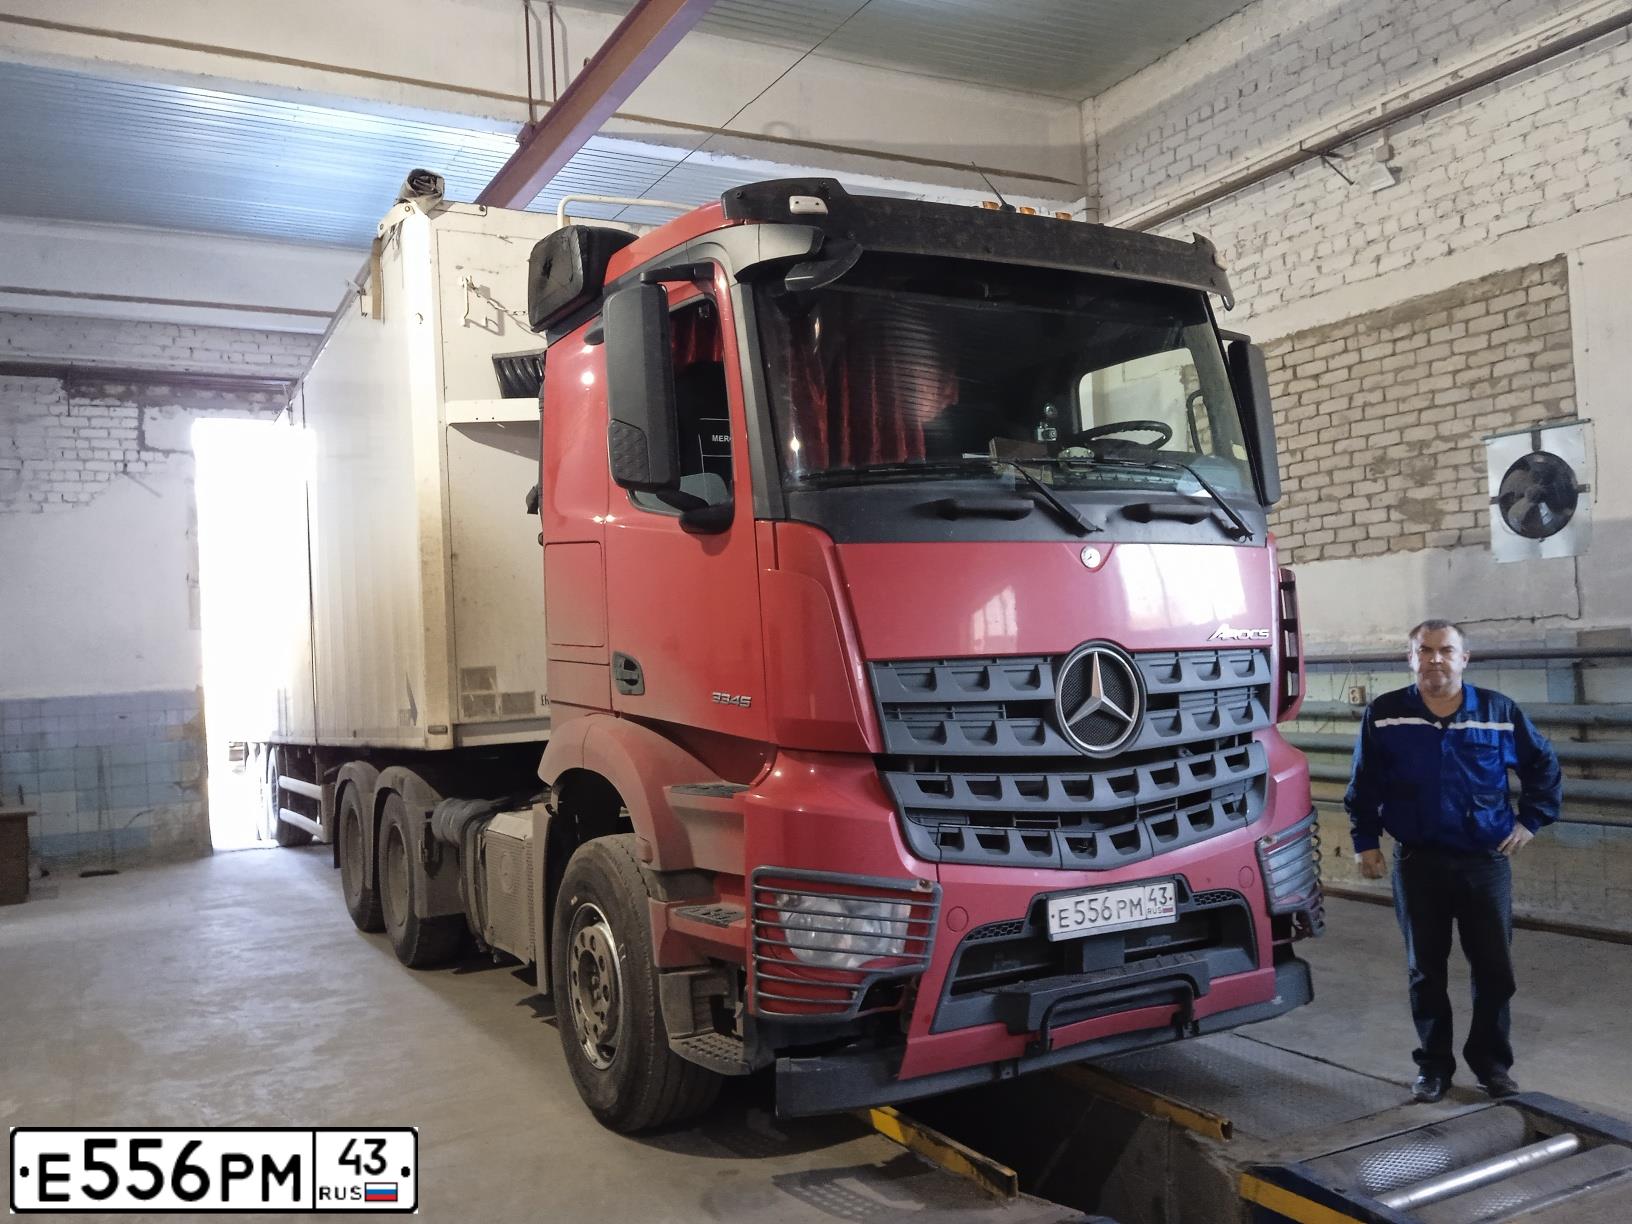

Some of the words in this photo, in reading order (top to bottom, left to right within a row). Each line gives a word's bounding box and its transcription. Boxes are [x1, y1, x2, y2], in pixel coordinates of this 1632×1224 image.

[712, 434, 732, 442] MER
[712, 691, 752, 708] 3345
[1149, 886, 1168, 907] 43
